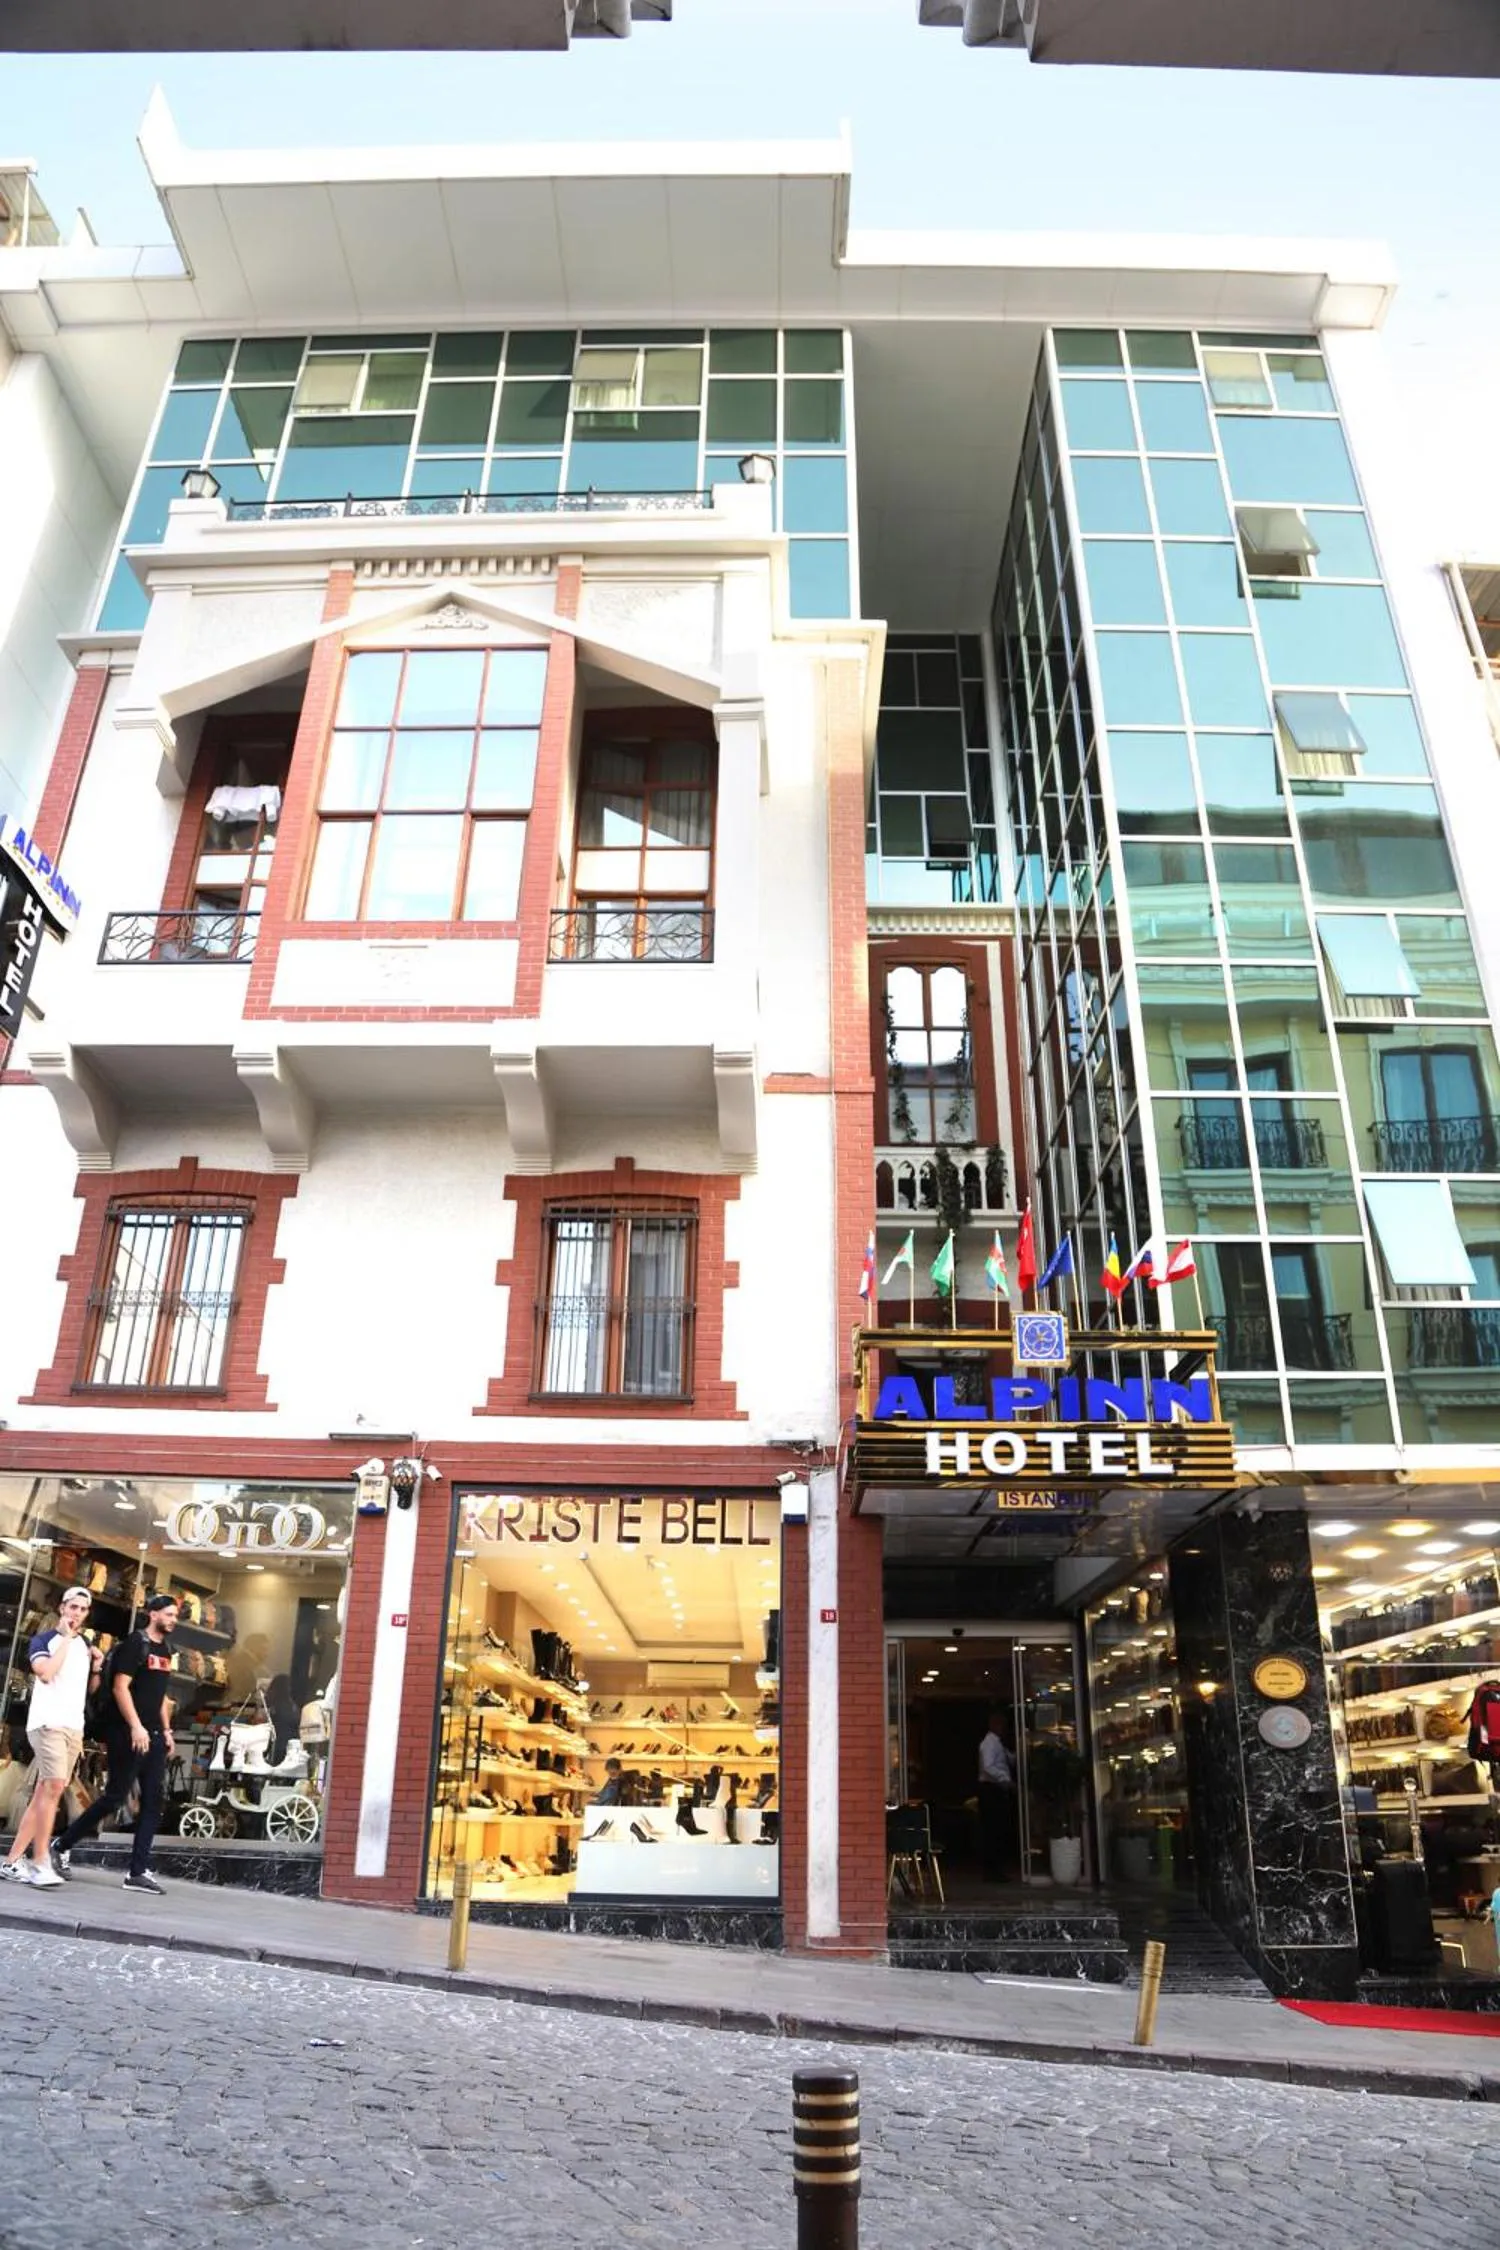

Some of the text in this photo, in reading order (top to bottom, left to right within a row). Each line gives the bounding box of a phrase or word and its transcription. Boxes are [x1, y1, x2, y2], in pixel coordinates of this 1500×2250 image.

[13, 827, 82, 920] ALPINN
[0, 892, 43, 1017] HOTEL
[873, 1376, 1213, 1422] ALPINN
[925, 1431, 1174, 1475] HOTEL
[461, 1496, 771, 1546] KRISTE BELL
